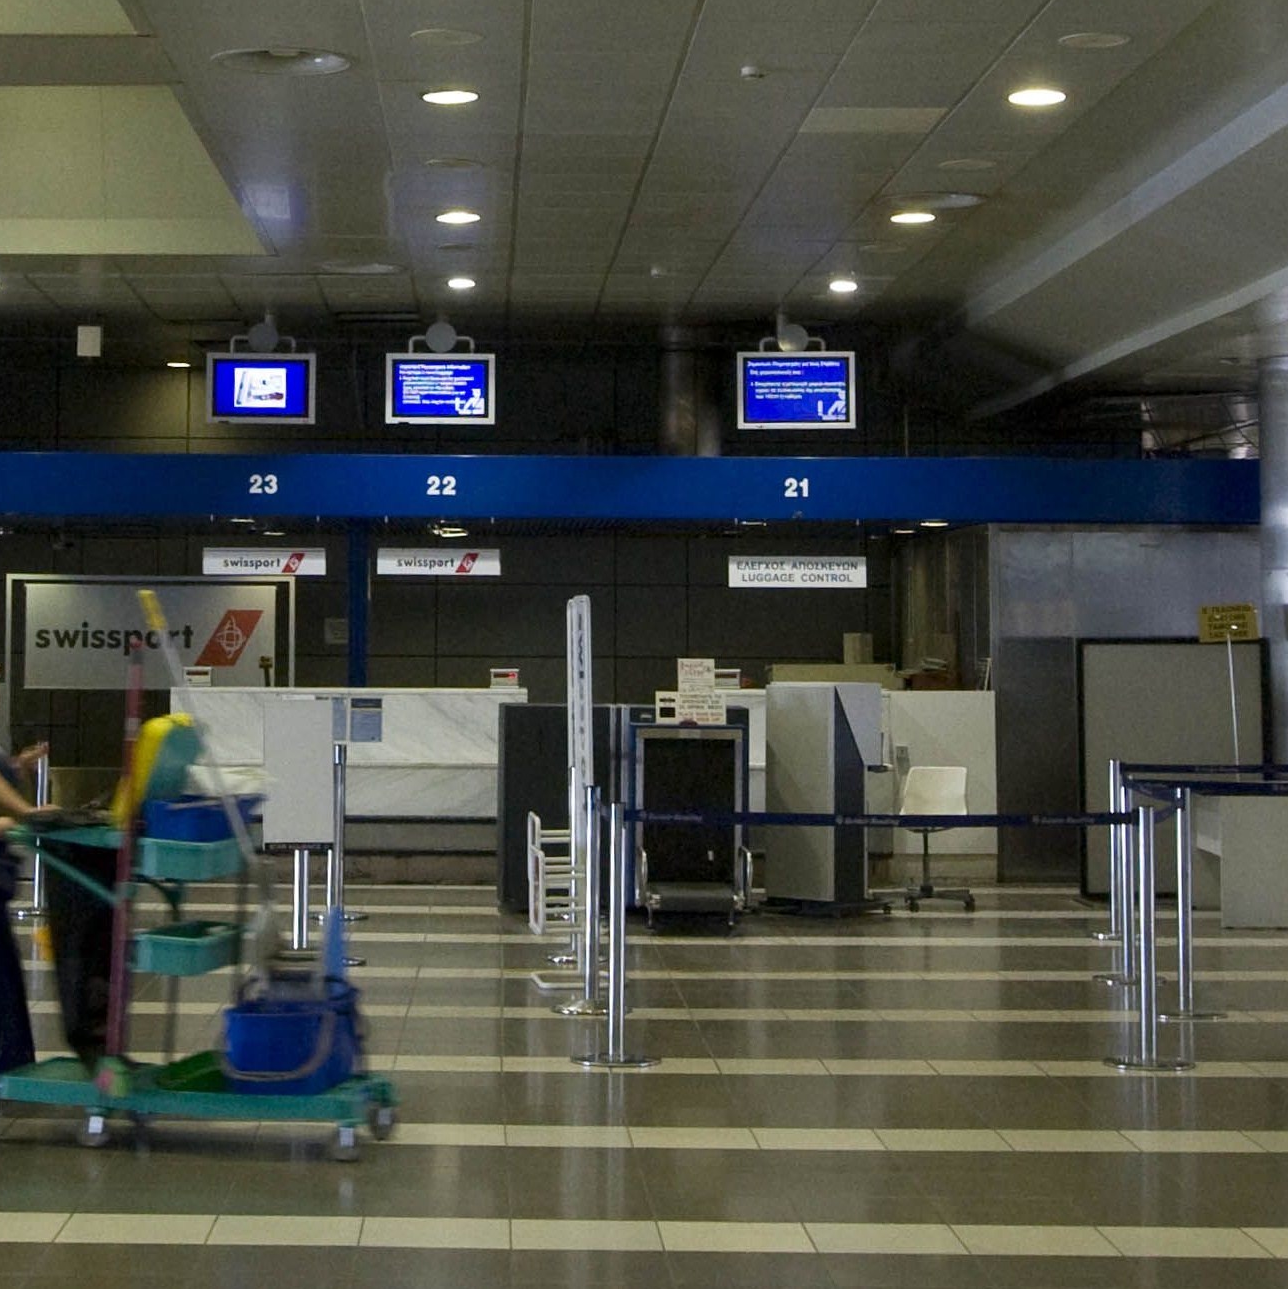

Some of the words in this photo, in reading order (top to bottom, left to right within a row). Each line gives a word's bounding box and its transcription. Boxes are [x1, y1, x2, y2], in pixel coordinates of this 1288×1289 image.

[249, 474, 279, 494] 23
[426, 475, 457, 496] 22
[784, 477, 809, 498] 21
[223, 556, 281, 570] swissport
[397, 556, 455, 570] swissport
[737, 561, 786, 571] ΕΛΕΓΧΟΣ
[791, 560, 859, 571] ΑΠΟΣΚΕΥΩΝ
[742, 573, 795, 583] LUGGAGE
[800, 573, 853, 583] CONTROL
[35, 621, 194, 657] swissport
